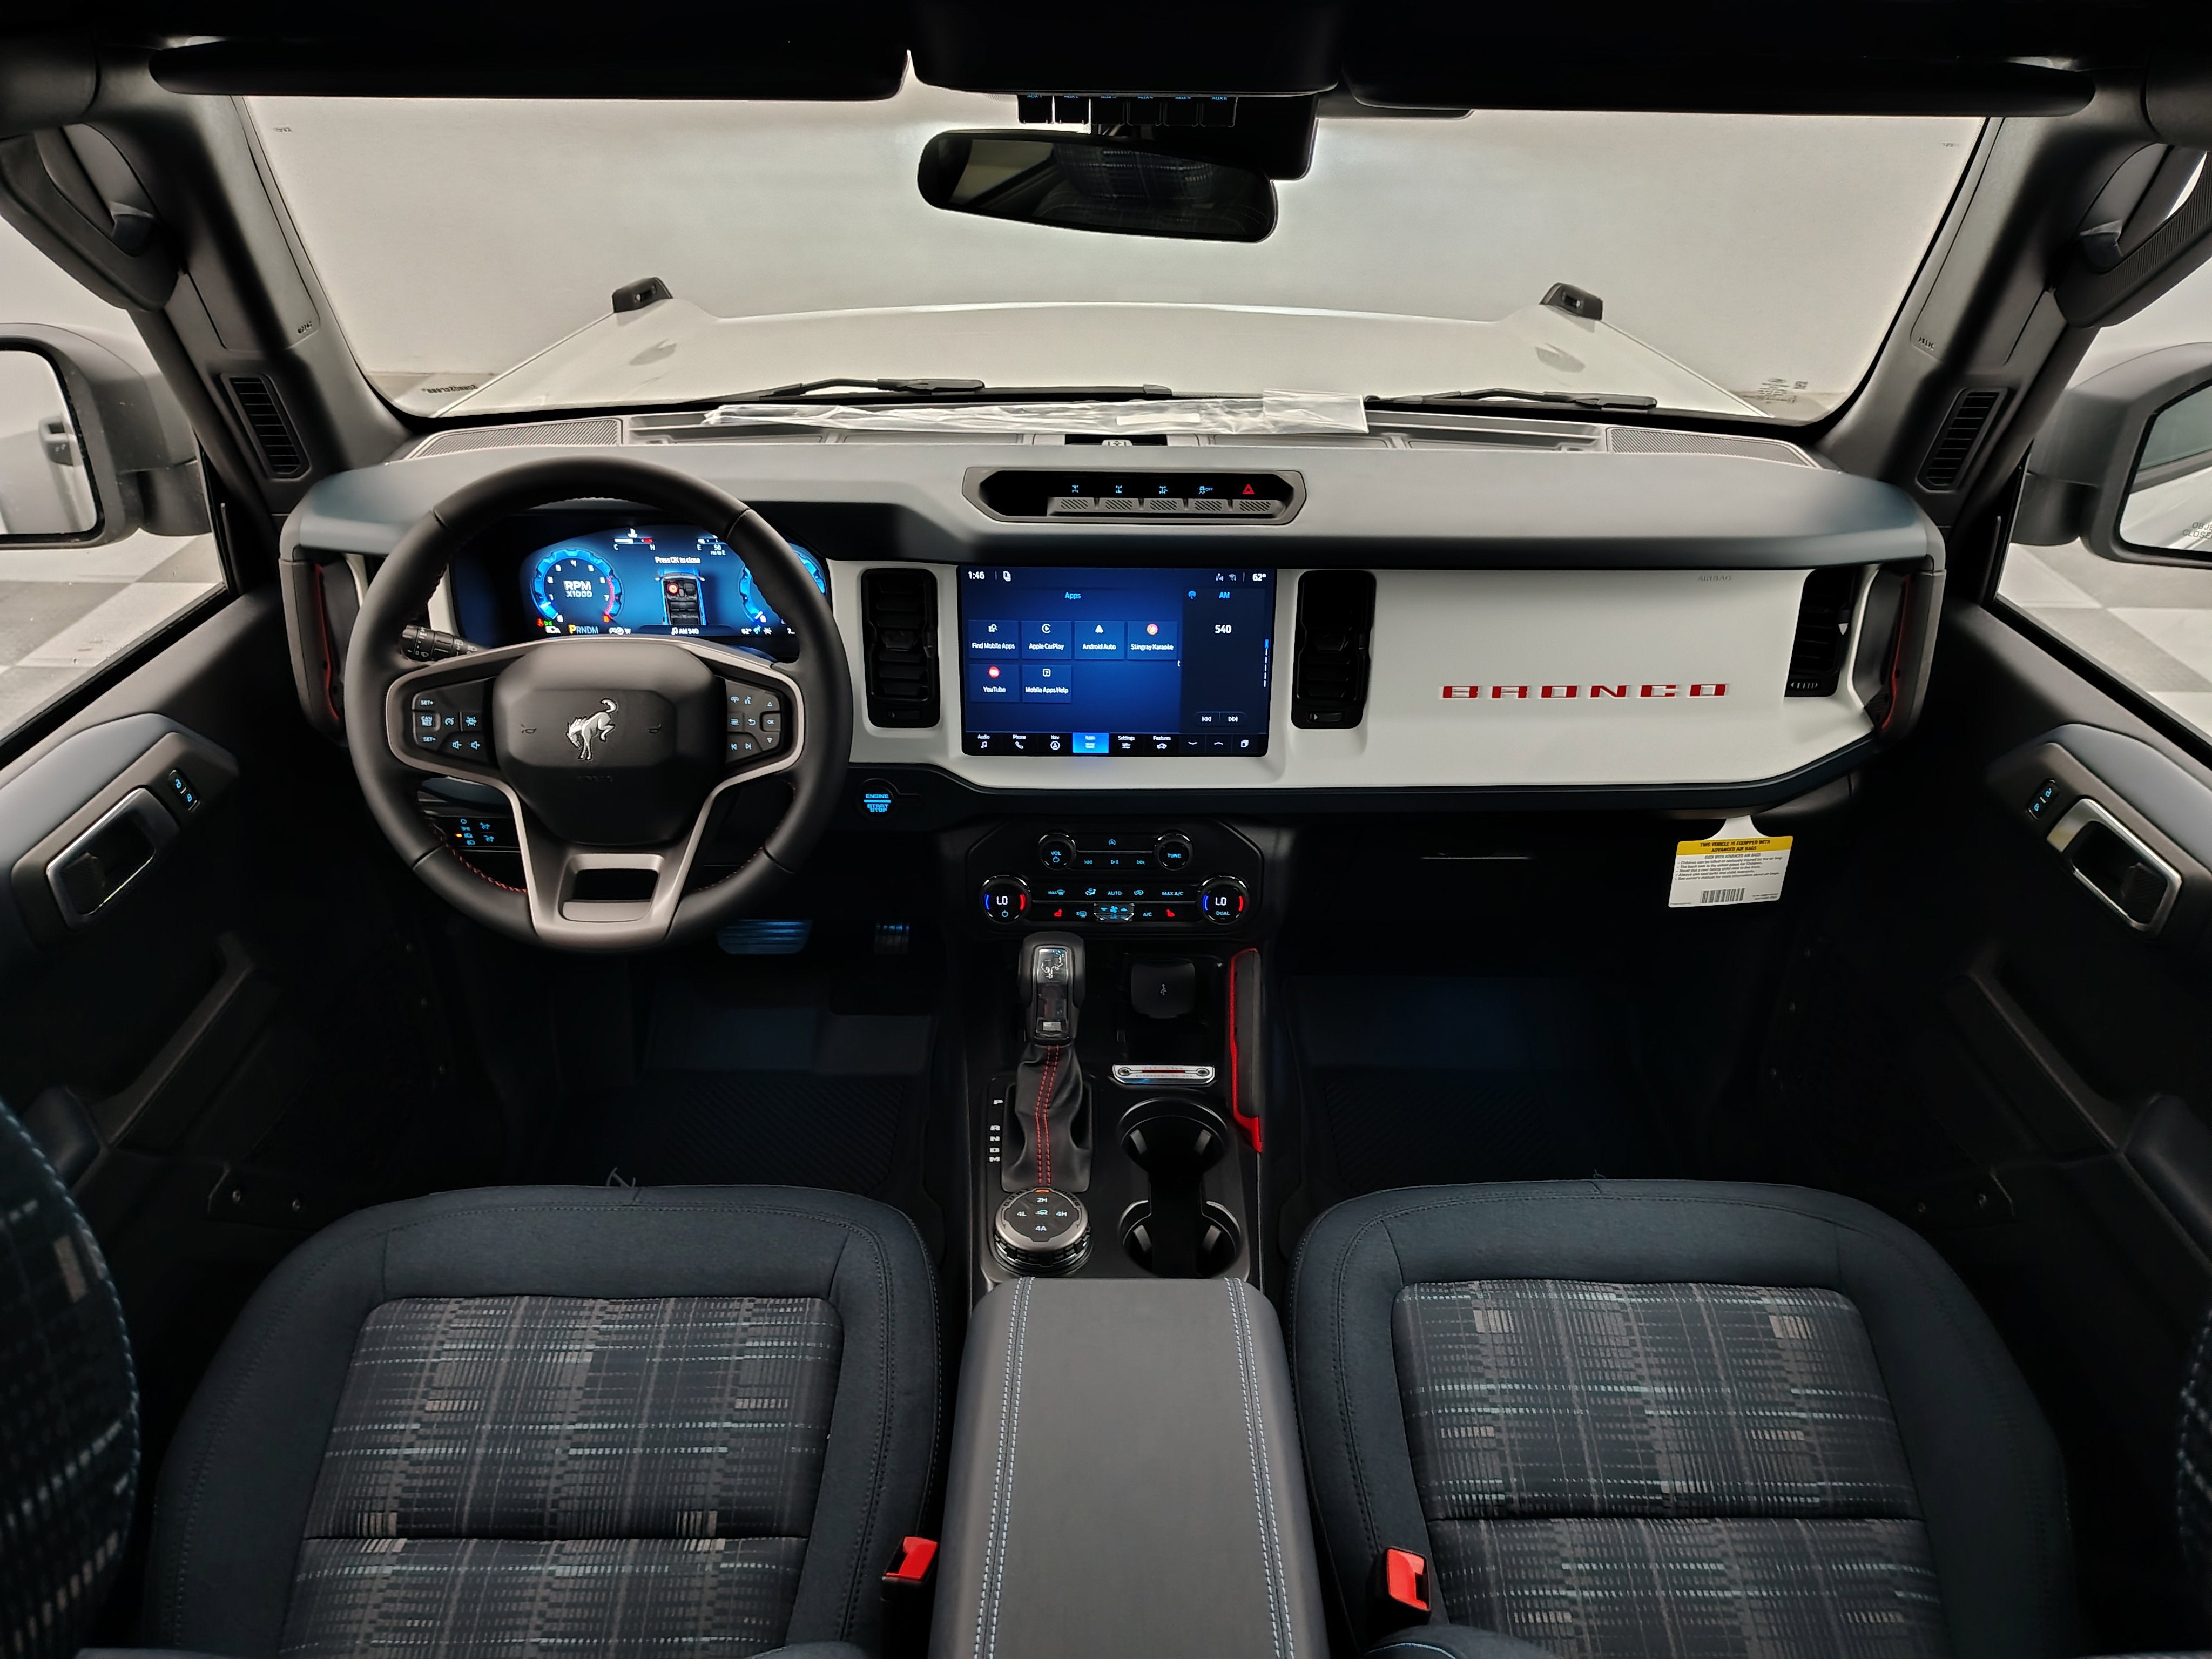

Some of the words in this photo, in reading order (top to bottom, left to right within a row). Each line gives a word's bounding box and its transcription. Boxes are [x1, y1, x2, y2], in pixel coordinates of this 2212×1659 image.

[2182, 529, 2212, 539] CLOSE
[968, 571, 985, 579] 1:46
[1252, 574, 1266, 582] 62°
[563, 581, 592, 591] RPM
[1065, 592, 1081, 600] Apps
[1215, 625, 1232, 633] 540
[1442, 683, 1727, 699] BRONCO
[996, 896, 1008, 905] LO
[1215, 897, 1227, 906] LO
